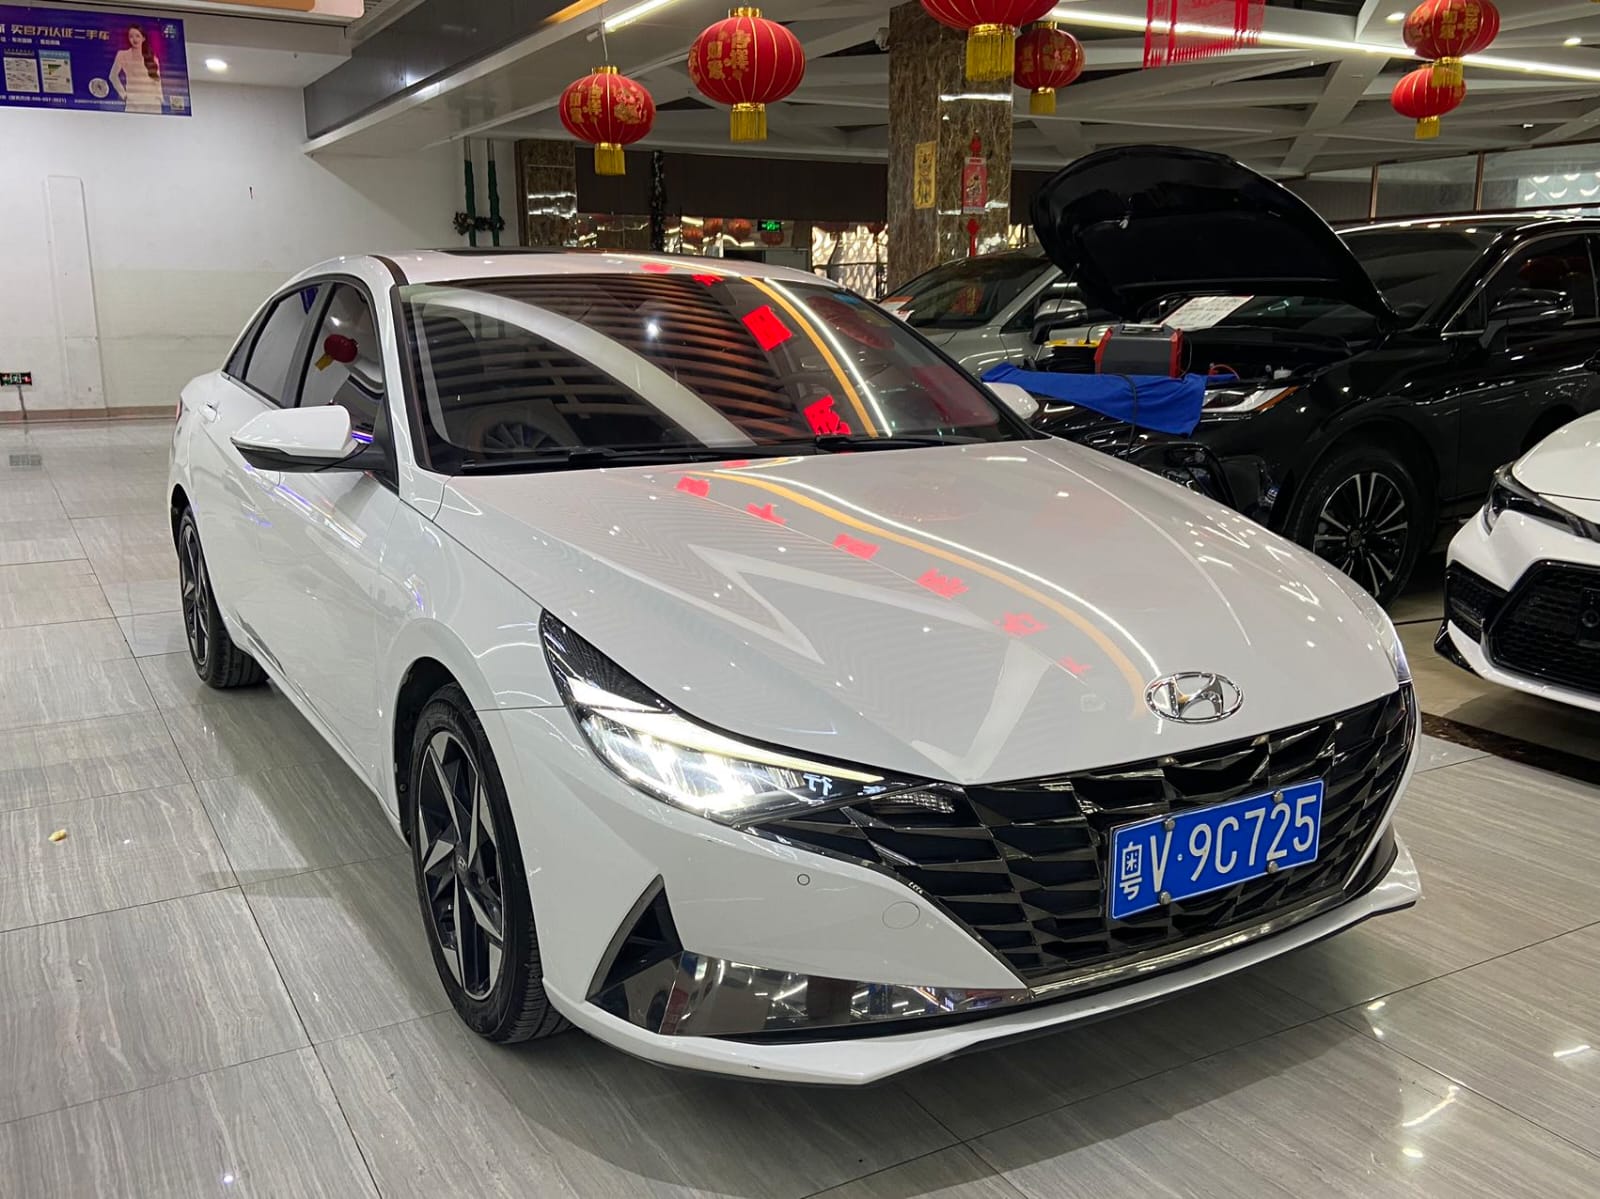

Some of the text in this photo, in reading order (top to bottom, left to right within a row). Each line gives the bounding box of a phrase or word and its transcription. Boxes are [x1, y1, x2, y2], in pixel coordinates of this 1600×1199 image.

[10, 23, 111, 41] 买官方认证二手车
[1119, 795, 1317, 900] 粤V·9C725
